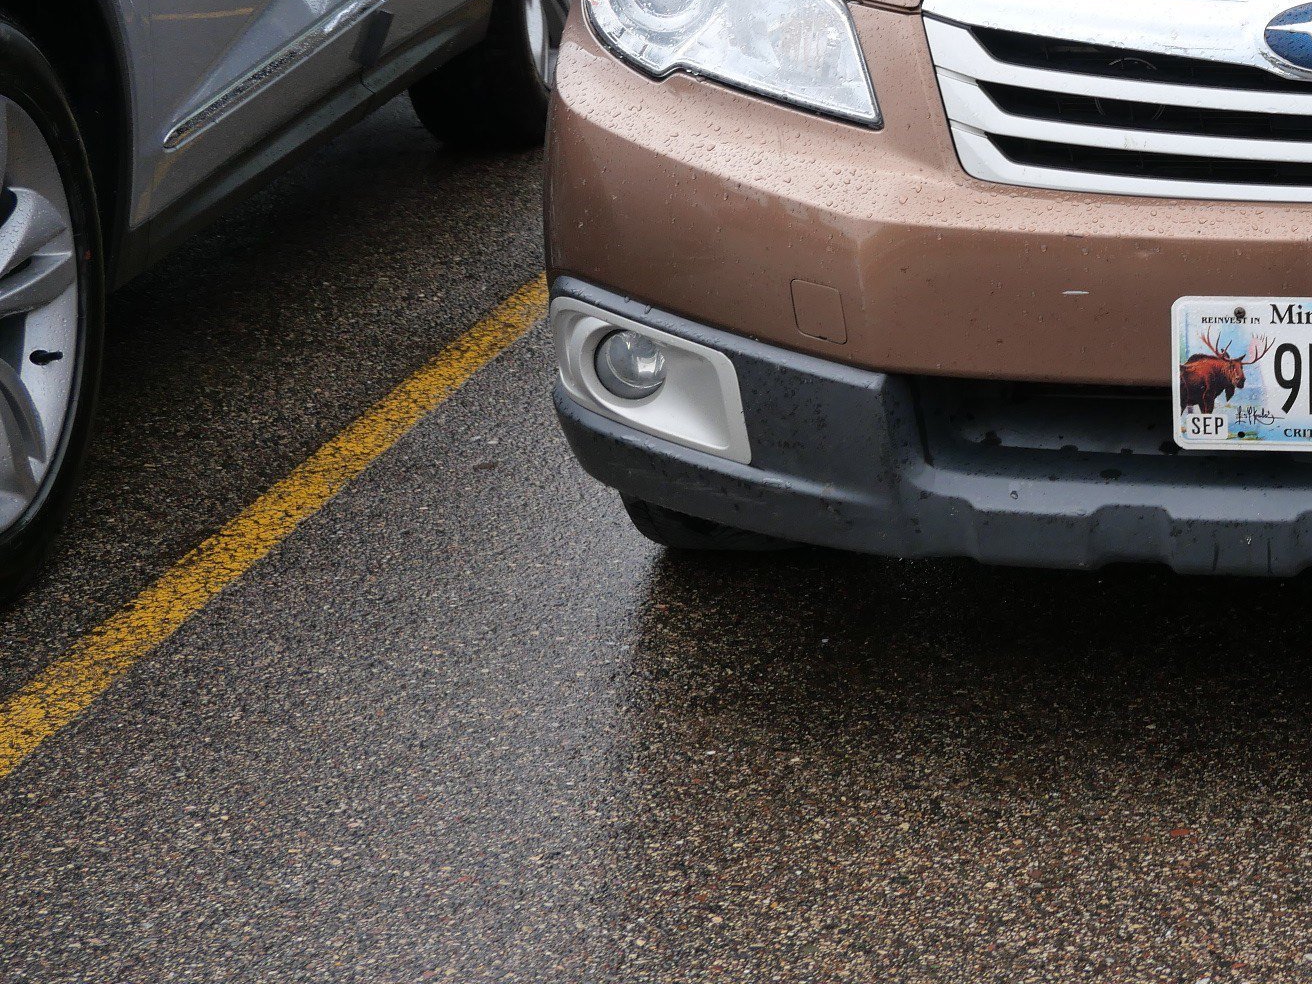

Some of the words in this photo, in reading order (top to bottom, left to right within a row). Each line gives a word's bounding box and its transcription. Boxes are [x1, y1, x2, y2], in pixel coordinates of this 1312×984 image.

[1201, 315, 1247, 325] REINVEST
[1250, 316, 1261, 325] IN
[1191, 416, 1225, 435] SEP
